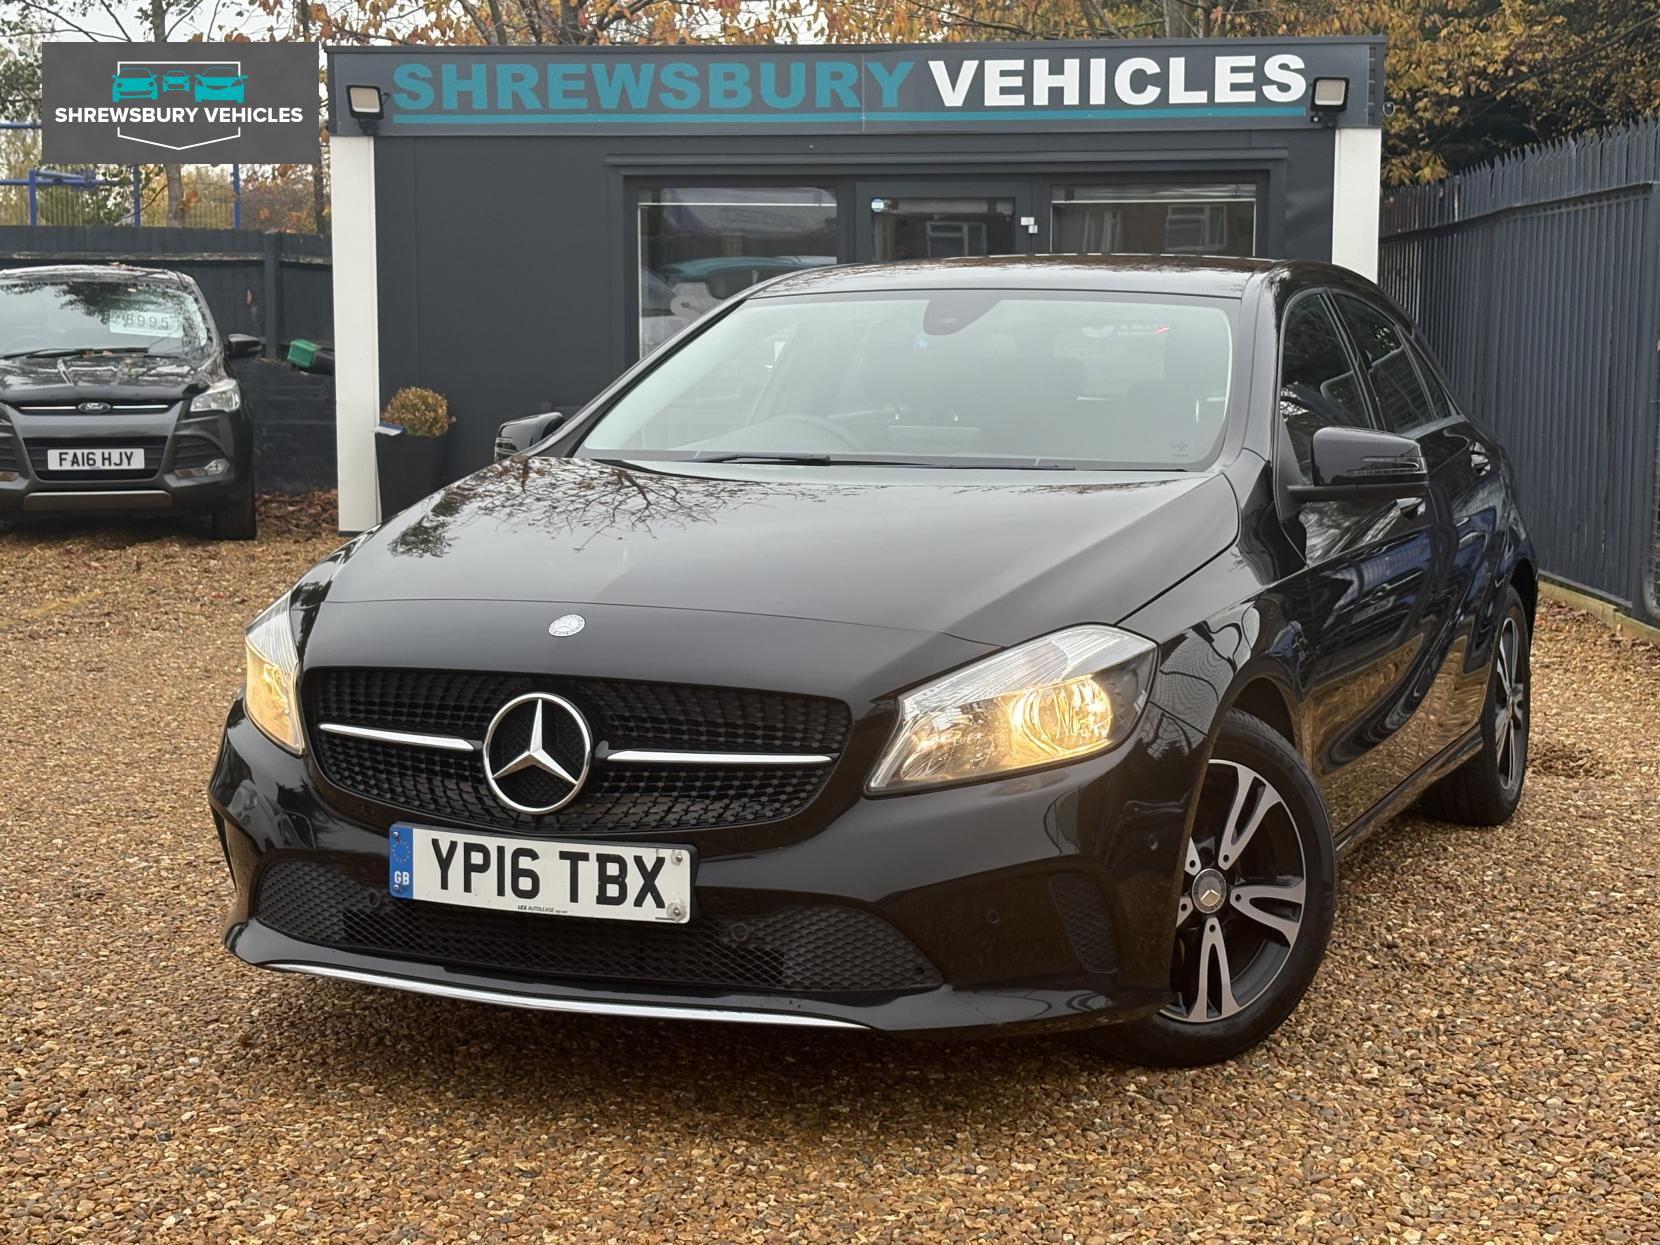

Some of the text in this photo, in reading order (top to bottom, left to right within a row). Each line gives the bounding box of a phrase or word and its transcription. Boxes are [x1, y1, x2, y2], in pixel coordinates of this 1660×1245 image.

[393, 54, 1307, 110] SHREWSBURY VEHICLES
[58, 452, 134, 467] FA16 HJY
[394, 870, 410, 885] GB
[431, 838, 666, 909] YP16 TBX
